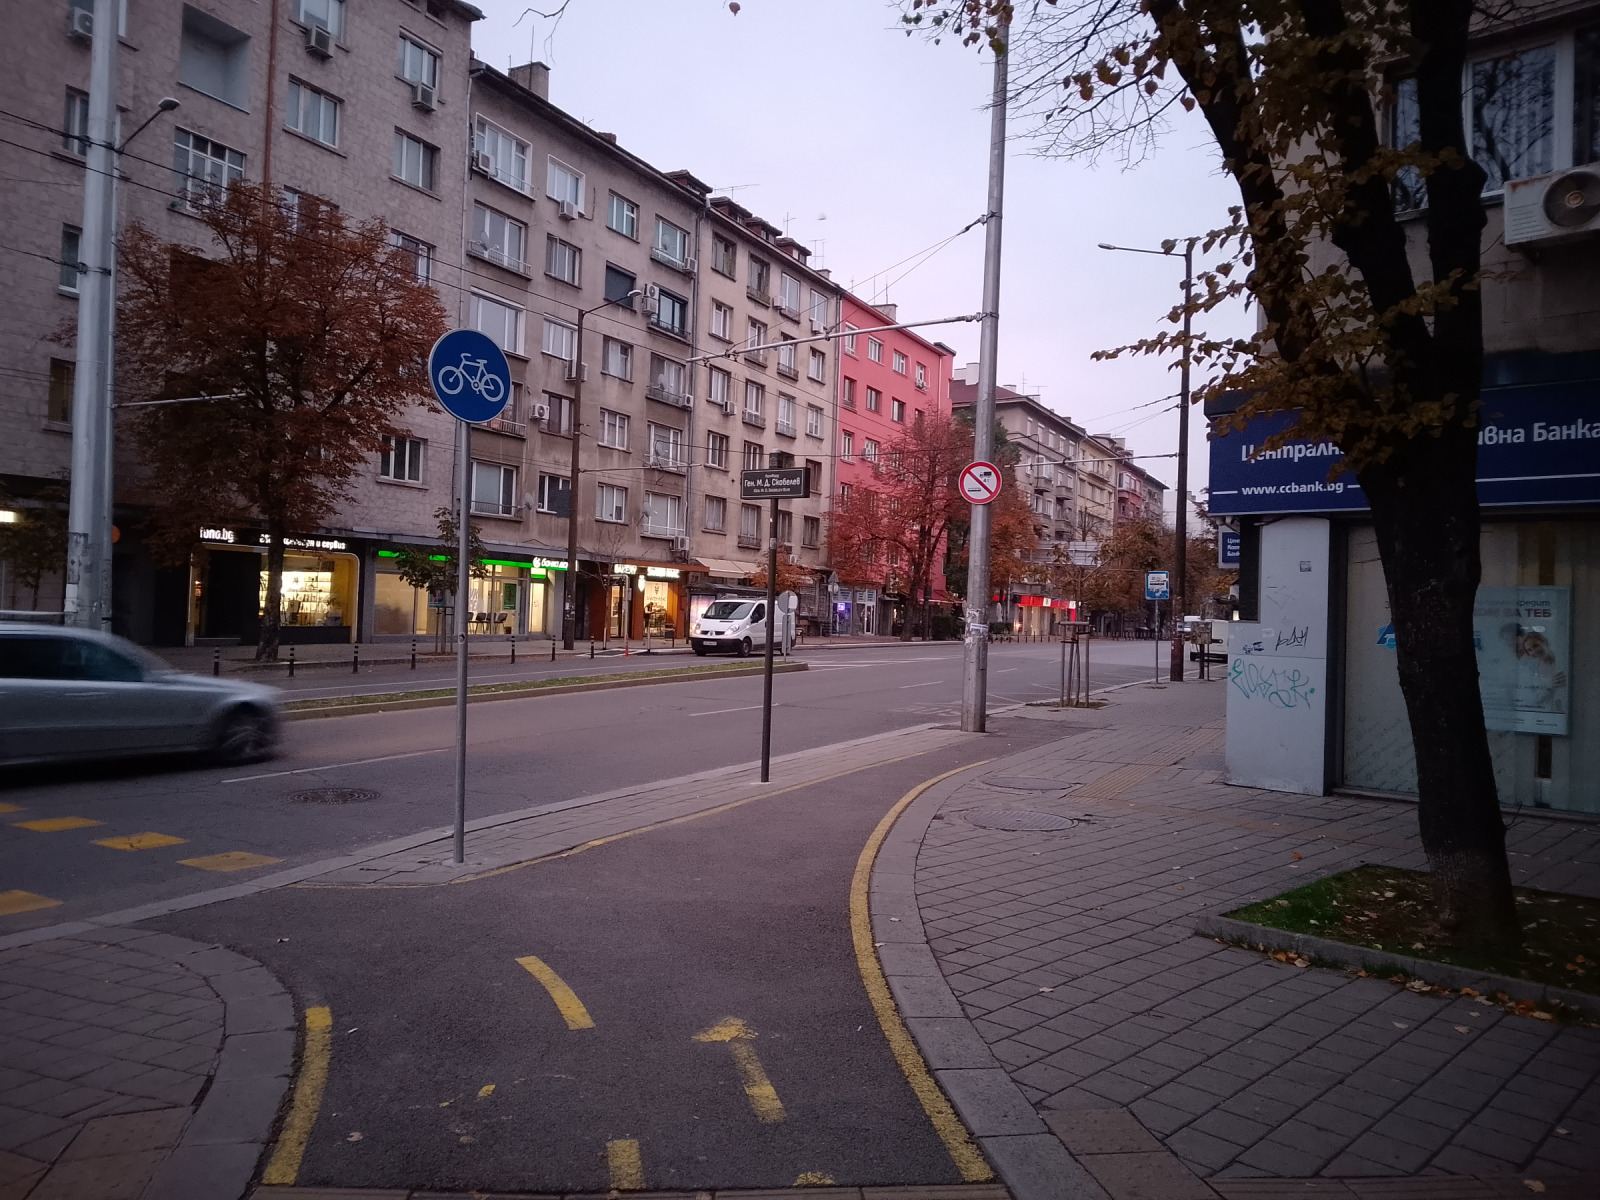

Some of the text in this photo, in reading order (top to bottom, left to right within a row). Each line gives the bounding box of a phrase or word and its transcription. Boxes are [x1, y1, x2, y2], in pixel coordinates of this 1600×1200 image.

[1532, 418, 1600, 442] Банка
[756, 479, 764, 487] М.
[764, 479, 771, 487] Д.
[771, 477, 801, 486] Скобелев
[1241, 481, 1344, 495] www.ccbank.bg
[321, 540, 346, 550] сервиз
[1524, 607, 1553, 618] ТЕБ
